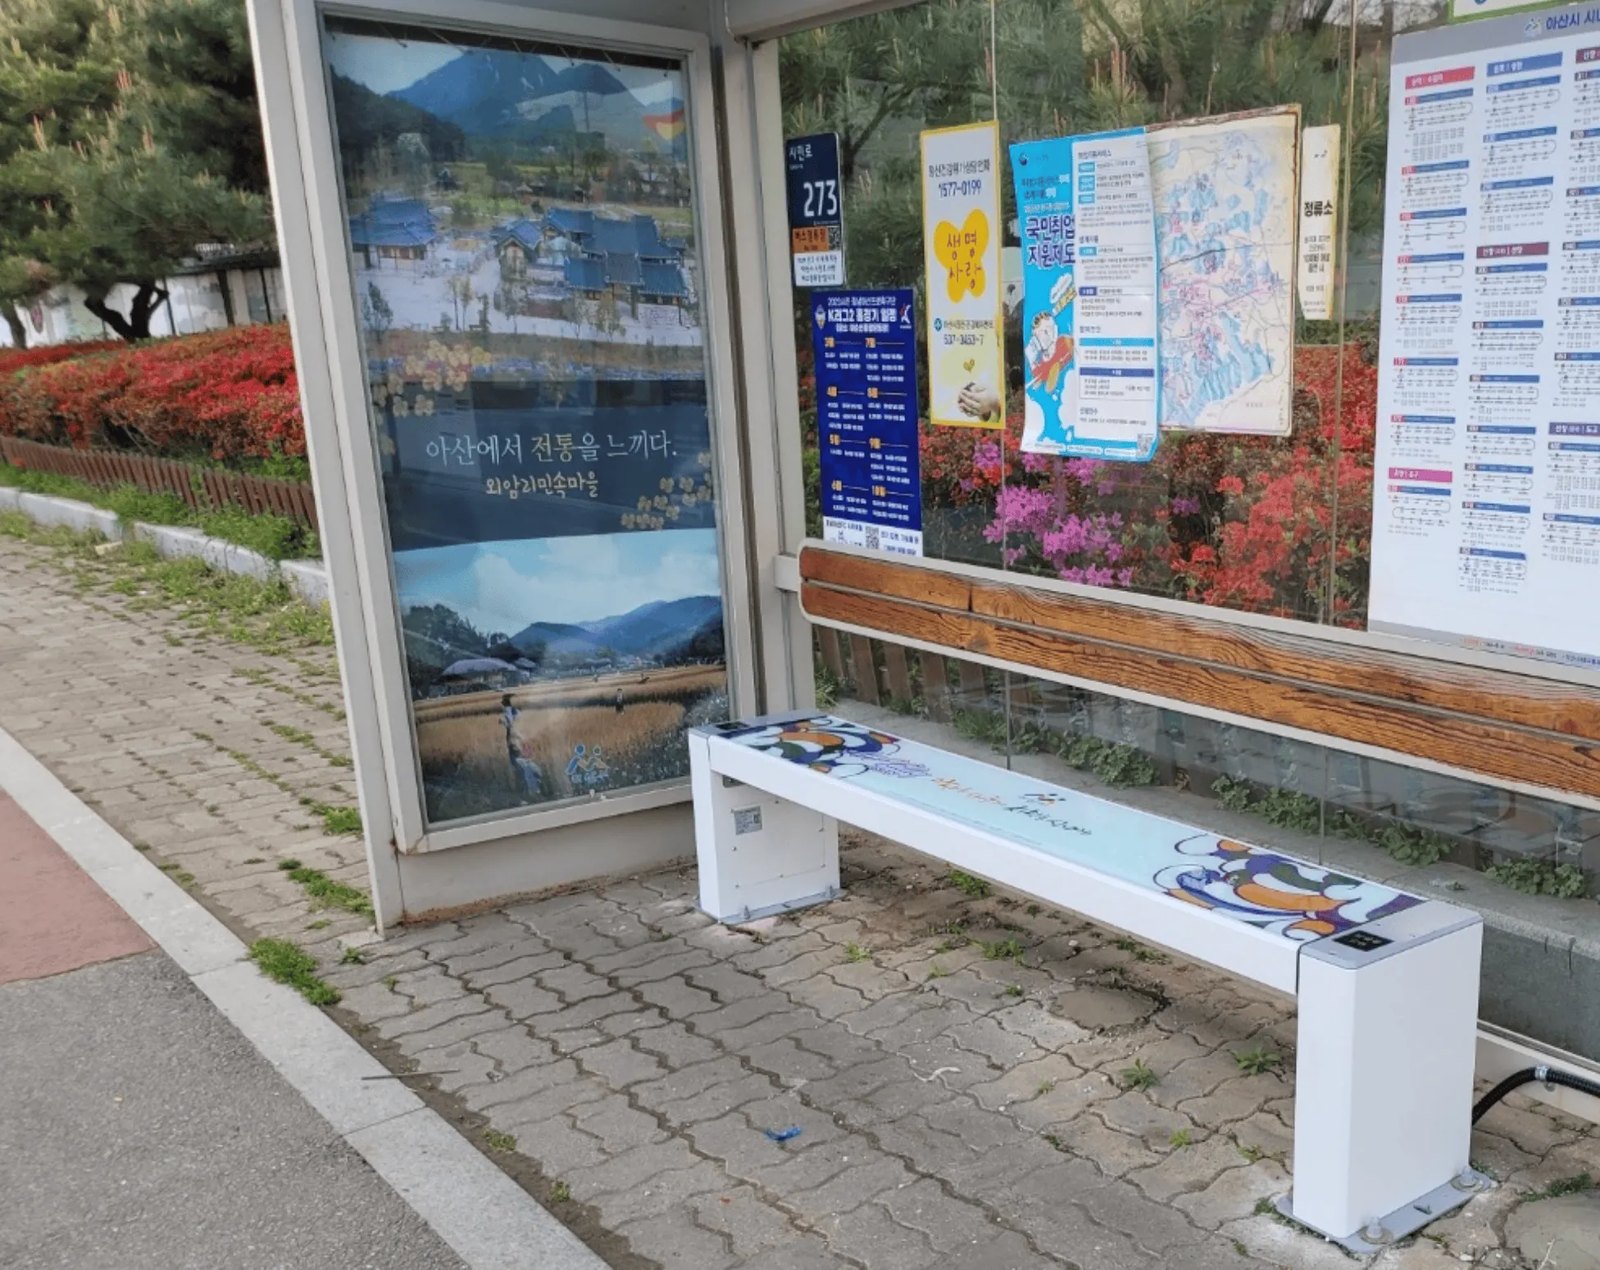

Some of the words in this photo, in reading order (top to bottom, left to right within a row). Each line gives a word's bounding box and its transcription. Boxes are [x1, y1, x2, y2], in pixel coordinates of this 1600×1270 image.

[1546, 14, 1580, 30] 아산시
[803, 180, 838, 218] 273
[938, 179, 982, 198] 1577-0199
[1304, 200, 1333, 217] 정류소
[1026, 214, 1075, 242] 국민취업
[946, 229, 978, 261] 생명
[1028, 242, 1076, 268] 지원제도
[948, 260, 983, 290] 사랑
[426, 433, 523, 466] 아산에서
[530, 431, 600, 463] 전통을
[606, 429, 677, 460] 느끼다.
[485, 470, 599, 500] 외암리민속마을
